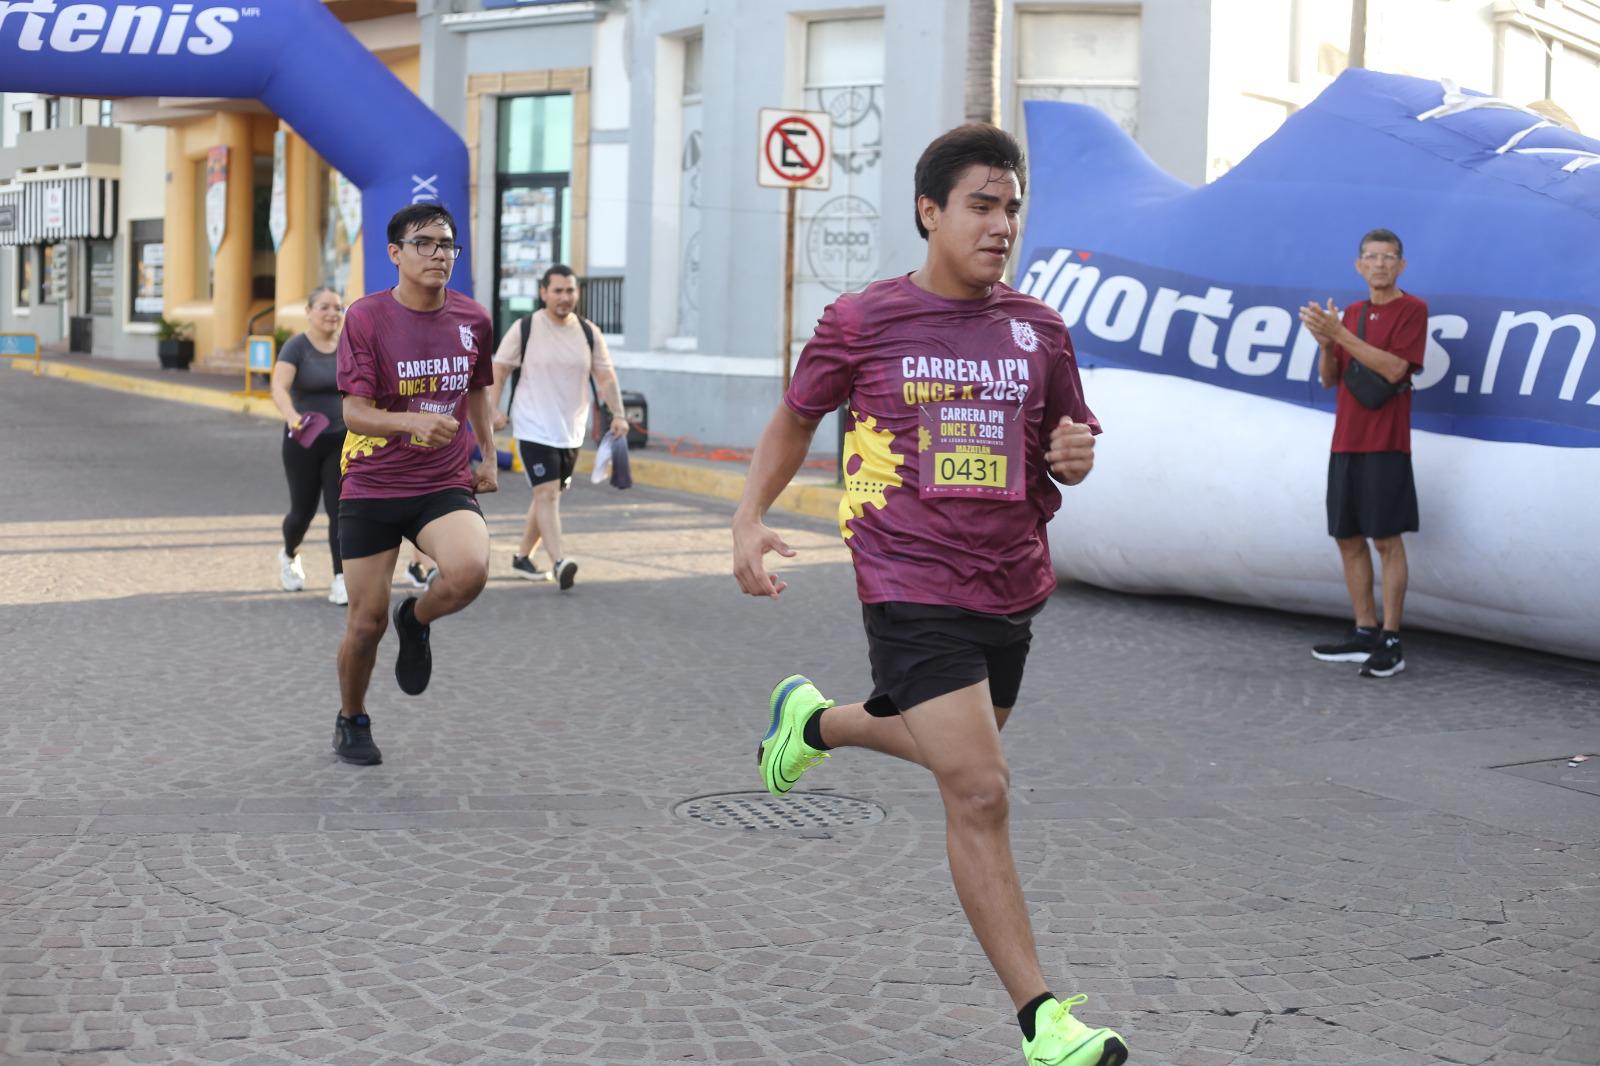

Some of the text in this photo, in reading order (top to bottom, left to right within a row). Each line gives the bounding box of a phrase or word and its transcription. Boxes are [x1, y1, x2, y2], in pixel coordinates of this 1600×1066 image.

[781, 129, 810, 168] E
[823, 228, 869, 246] boba
[397, 356, 469, 378] CARRERA IPN
[902, 356, 1029, 382] CARRERA IPN
[399, 374, 468, 396] ONCE K 2026
[903, 381, 1029, 405] ONCE K 2026
[941, 407, 1004, 424] CARRERA IPN
[941, 423, 1004, 440] ONCE K 2026
[941, 458, 997, 482] 0431
